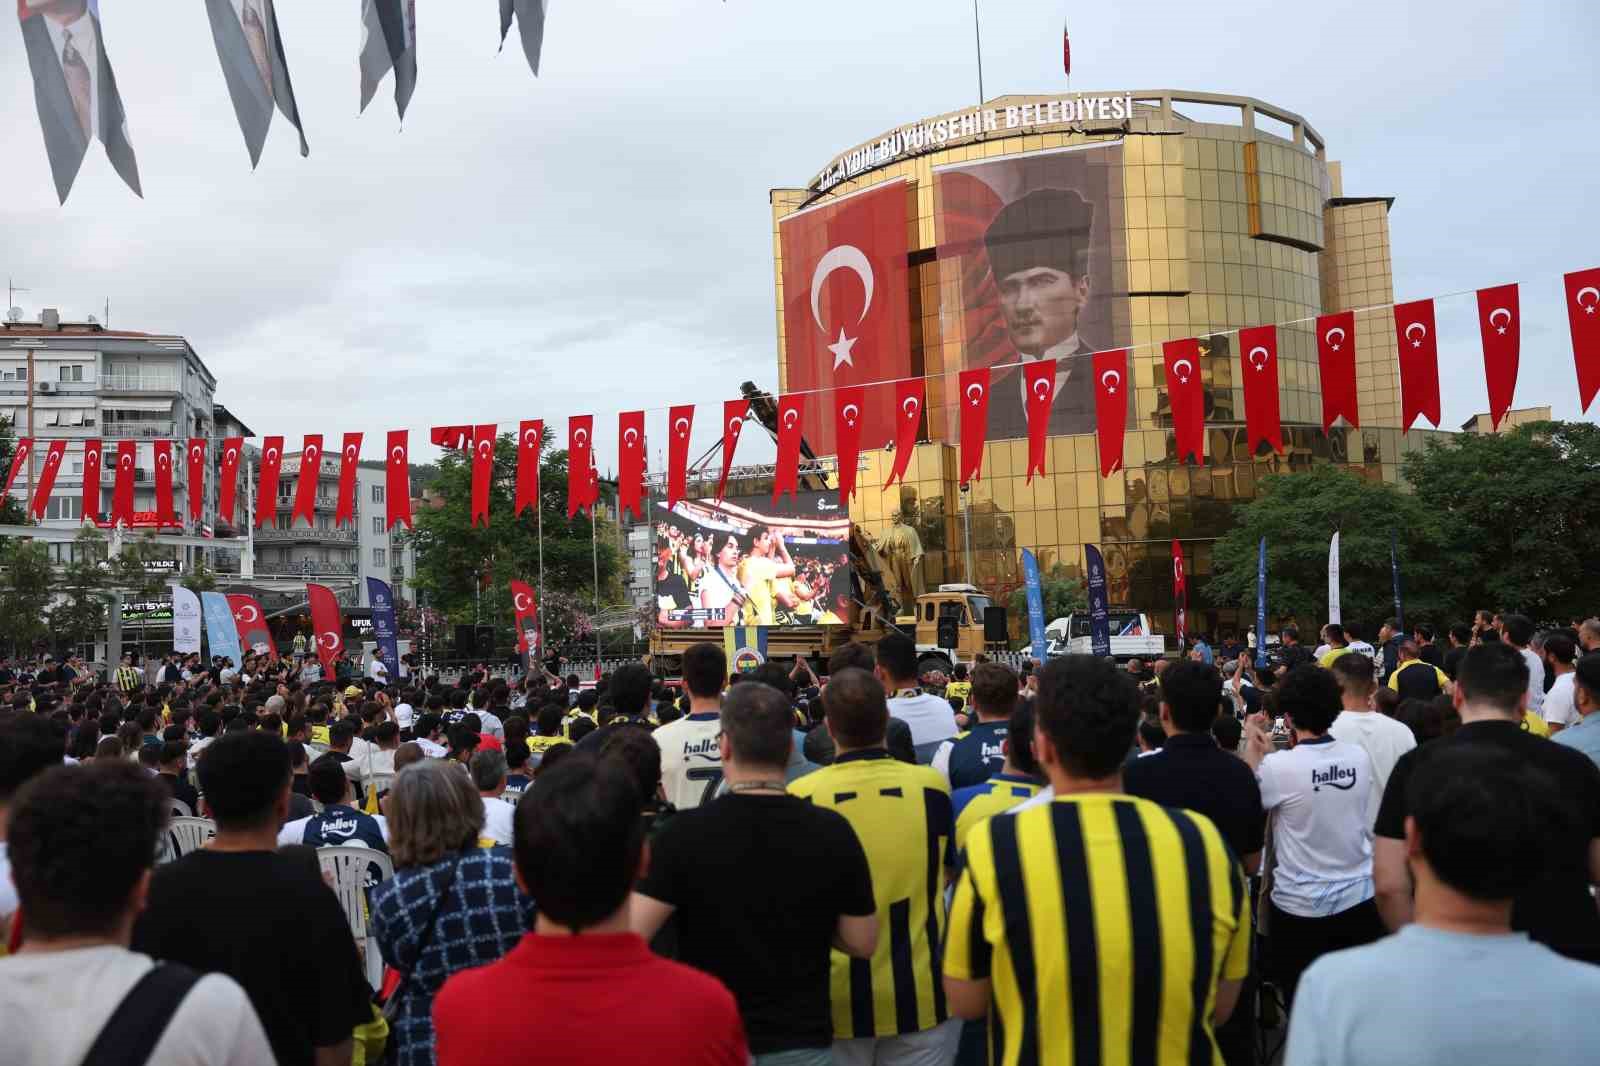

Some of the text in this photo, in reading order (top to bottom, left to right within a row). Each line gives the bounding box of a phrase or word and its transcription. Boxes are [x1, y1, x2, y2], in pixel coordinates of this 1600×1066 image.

[839, 142, 875, 178] AYDIN
[1005, 91, 1133, 129] BELEDİYESİ
[151, 560, 175, 568] YILDIZ
[351, 619, 372, 627] UFUK
[1311, 764, 1357, 790] halley
[320, 817, 358, 837] halley
